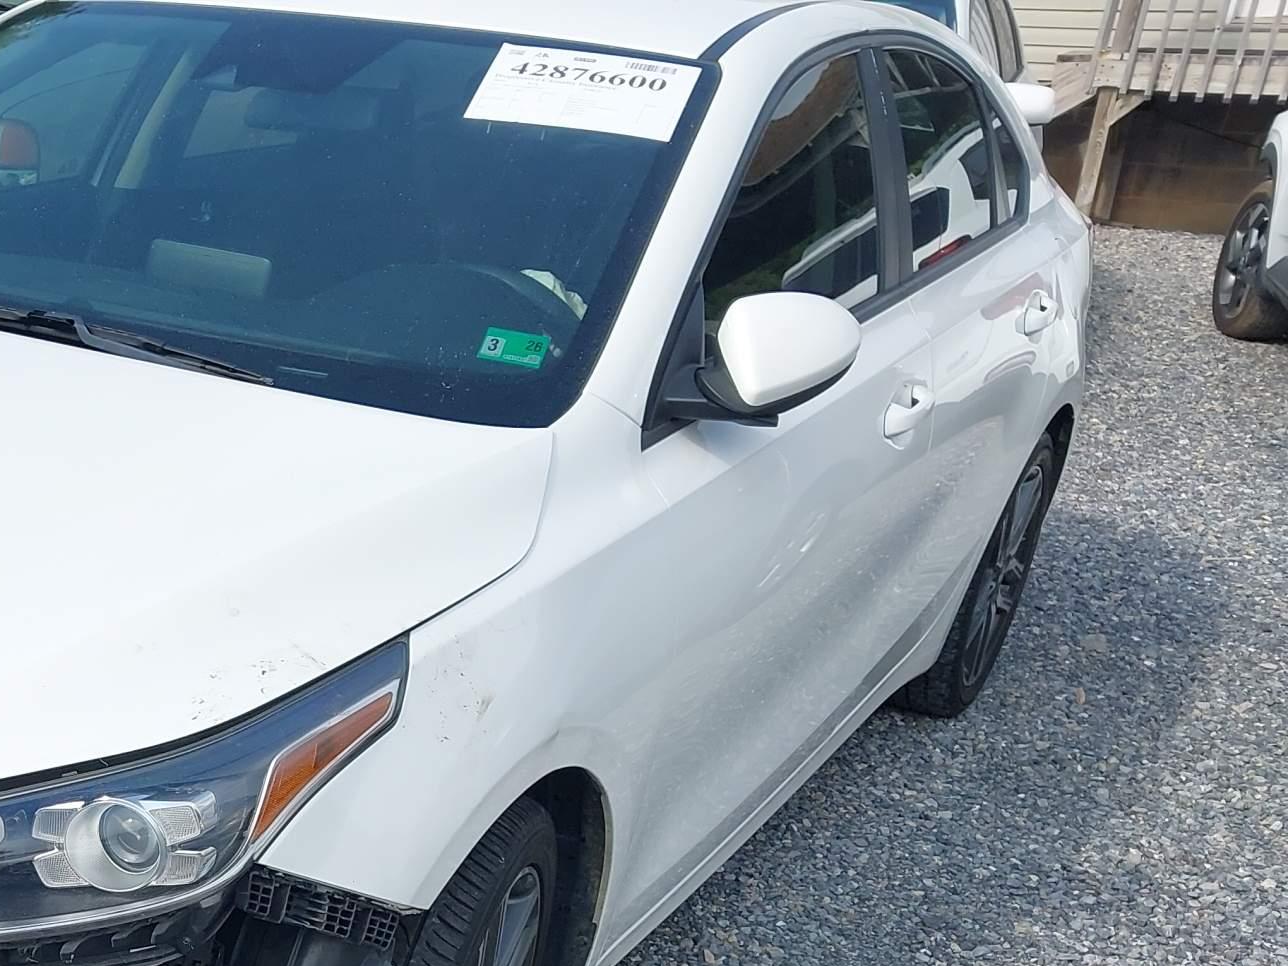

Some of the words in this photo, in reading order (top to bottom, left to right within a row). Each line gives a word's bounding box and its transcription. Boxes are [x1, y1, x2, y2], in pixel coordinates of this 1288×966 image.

[510, 61, 668, 92] 42876600
[487, 338, 500, 352] 3
[526, 340, 544, 353] 26
